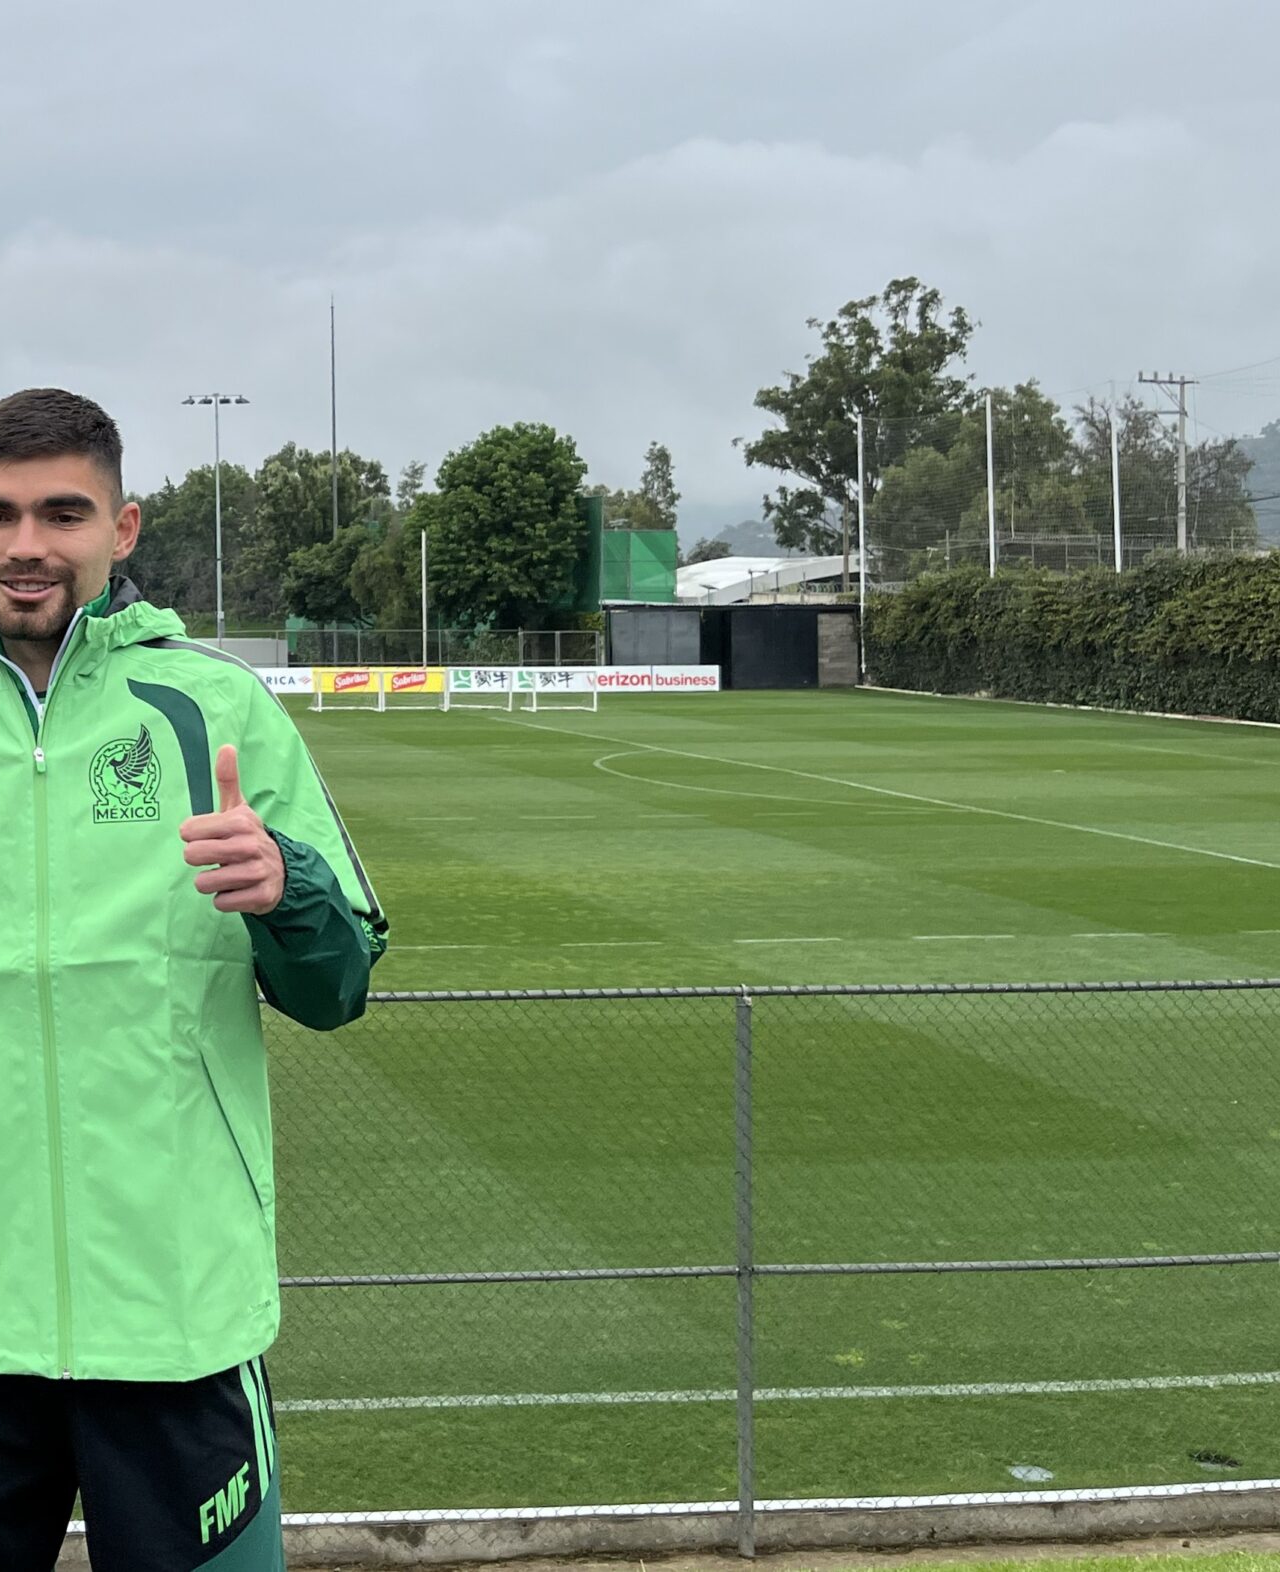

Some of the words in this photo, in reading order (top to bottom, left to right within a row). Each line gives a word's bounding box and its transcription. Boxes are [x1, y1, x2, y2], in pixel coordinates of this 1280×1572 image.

[266, 676, 296, 685] RICA
[655, 673, 716, 686] business
[96, 805, 156, 820] MÉXICO
[199, 1460, 250, 1545] FMF
